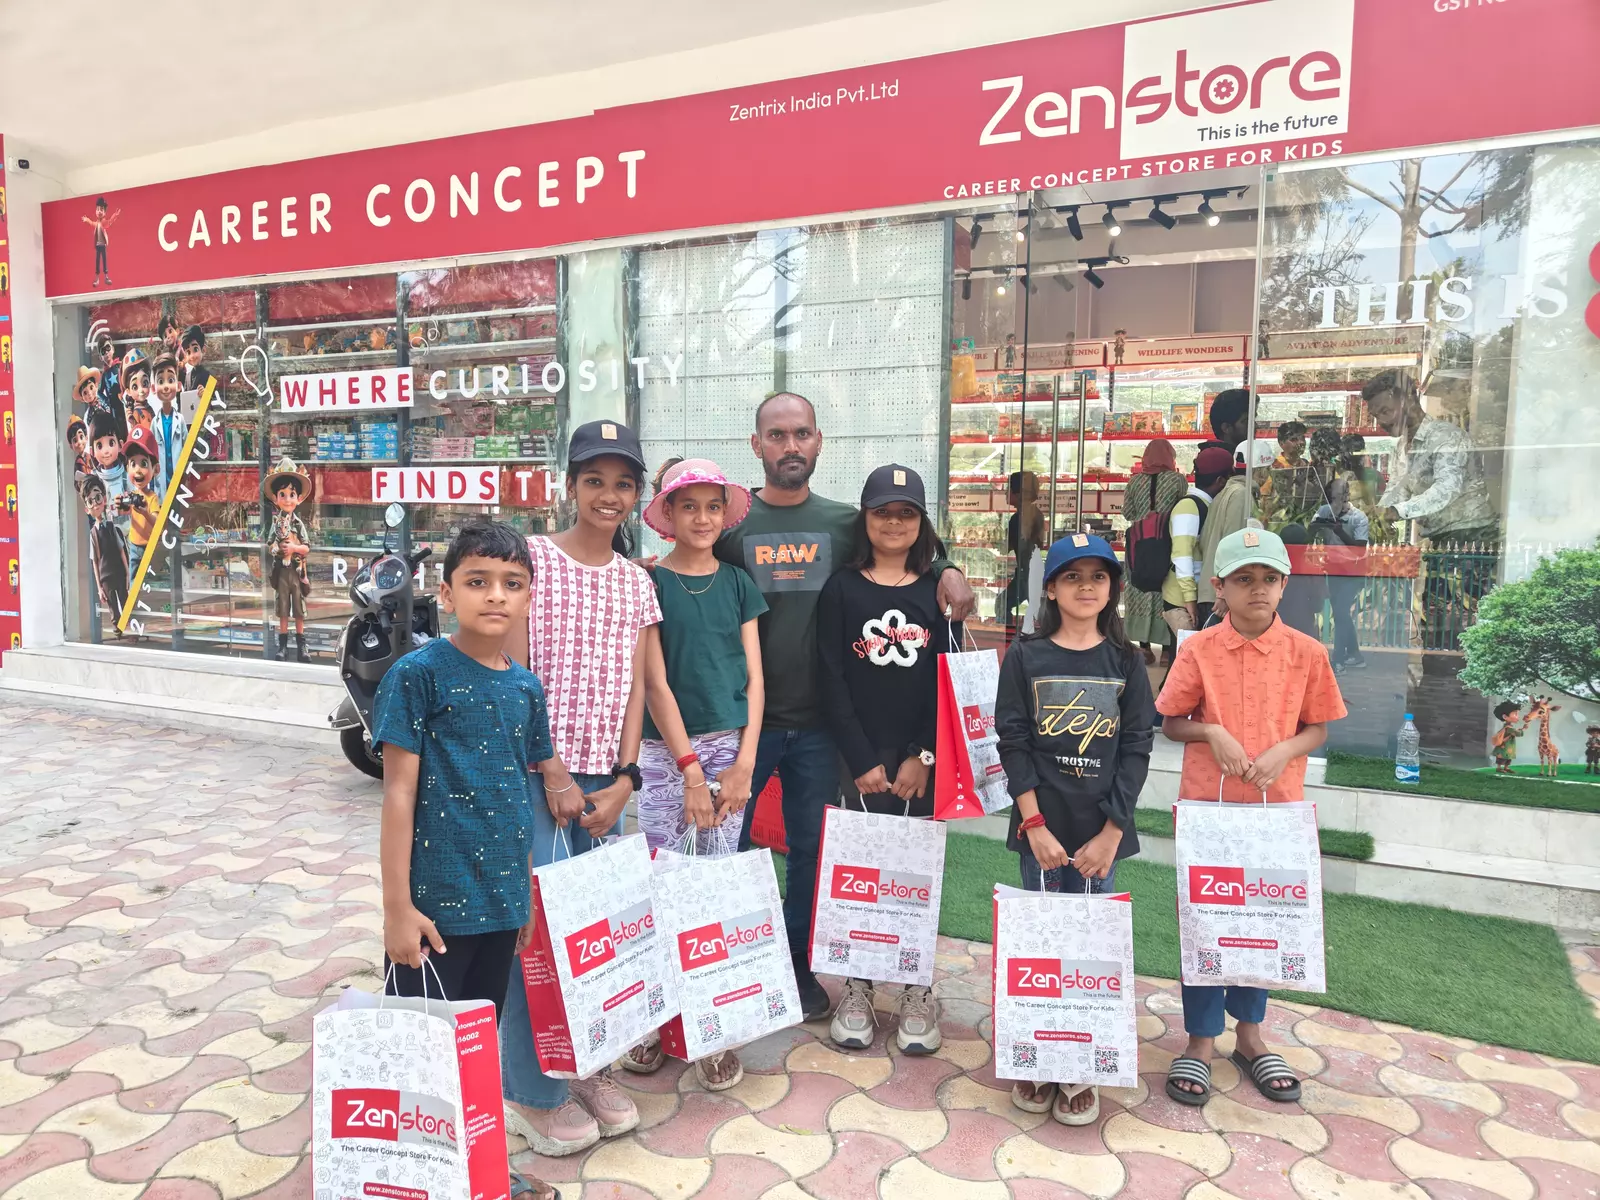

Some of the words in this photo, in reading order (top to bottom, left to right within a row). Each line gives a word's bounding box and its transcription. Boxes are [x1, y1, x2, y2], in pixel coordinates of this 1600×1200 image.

[729, 99, 786, 122] Zentrix
[790, 92, 832, 113] India
[836, 79, 899, 105] Pvt.Ltd
[978, 48, 1342, 147] Zenstore
[1196, 127, 1231, 142] This
[1235, 122, 1249, 138] is
[1251, 119, 1280, 135] the
[1283, 112, 1339, 131] future
[943, 177, 1022, 200] CAREER
[1030, 164, 1133, 190] CONCEPT
[1141, 154, 1216, 177] STORE
[1225, 147, 1272, 168] FOR
[1284, 138, 1343, 161] KIDS
[157, 192, 332, 252] CAREER
[365, 149, 647, 227] CONCEPT
[1309, 275, 1473, 329] THIS
[1497, 267, 1569, 320] IS
[1137, 348, 1183, 357] WILDLIFE
[1184, 345, 1234, 355] WONDERS
[284, 372, 411, 408] WHERE
[429, 353, 685, 401] CURIOSITY
[134, 430, 142, 439] A
[161, 390, 227, 550] CENTURY
[375, 470, 495, 501] FINDS
[515, 470, 567, 502] TH
[1038, 687, 1119, 756] steps
[840, 873, 930, 901] Zenstore
[1199, 874, 1307, 899] Zenstore
[845, 904, 863, 912] Career
[863, 906, 885, 915] Concept
[1209, 909, 1229, 917] Career
[1230, 910, 1256, 918] Concept
[575, 913, 654, 965] Zenstore
[685, 923, 774, 961] Zenstore
[581, 979, 591, 987] The
[590, 970, 606, 982] Career
[606, 962, 625, 974] Concept
[624, 953, 637, 964] Store
[699, 969, 717, 978] Career
[717, 961, 740, 973] Concept
[1017, 966, 1121, 991] Zenstore
[1046, 1003, 1072, 1011] Concept
[1072, 1003, 1088, 1011] Store
[346, 1098, 458, 1143] Zenstore
[340, 1144, 355, 1153] The
[355, 1145, 379, 1154] Career
[380, 1147, 408, 1159] Concept
[409, 1151, 426, 1160] Store
[427, 1153, 439, 1162] For
[439, 1156, 453, 1166] Kids
[421, 1136, 433, 1144] This
[365, 1184, 427, 1200] www.zenstores.shop
